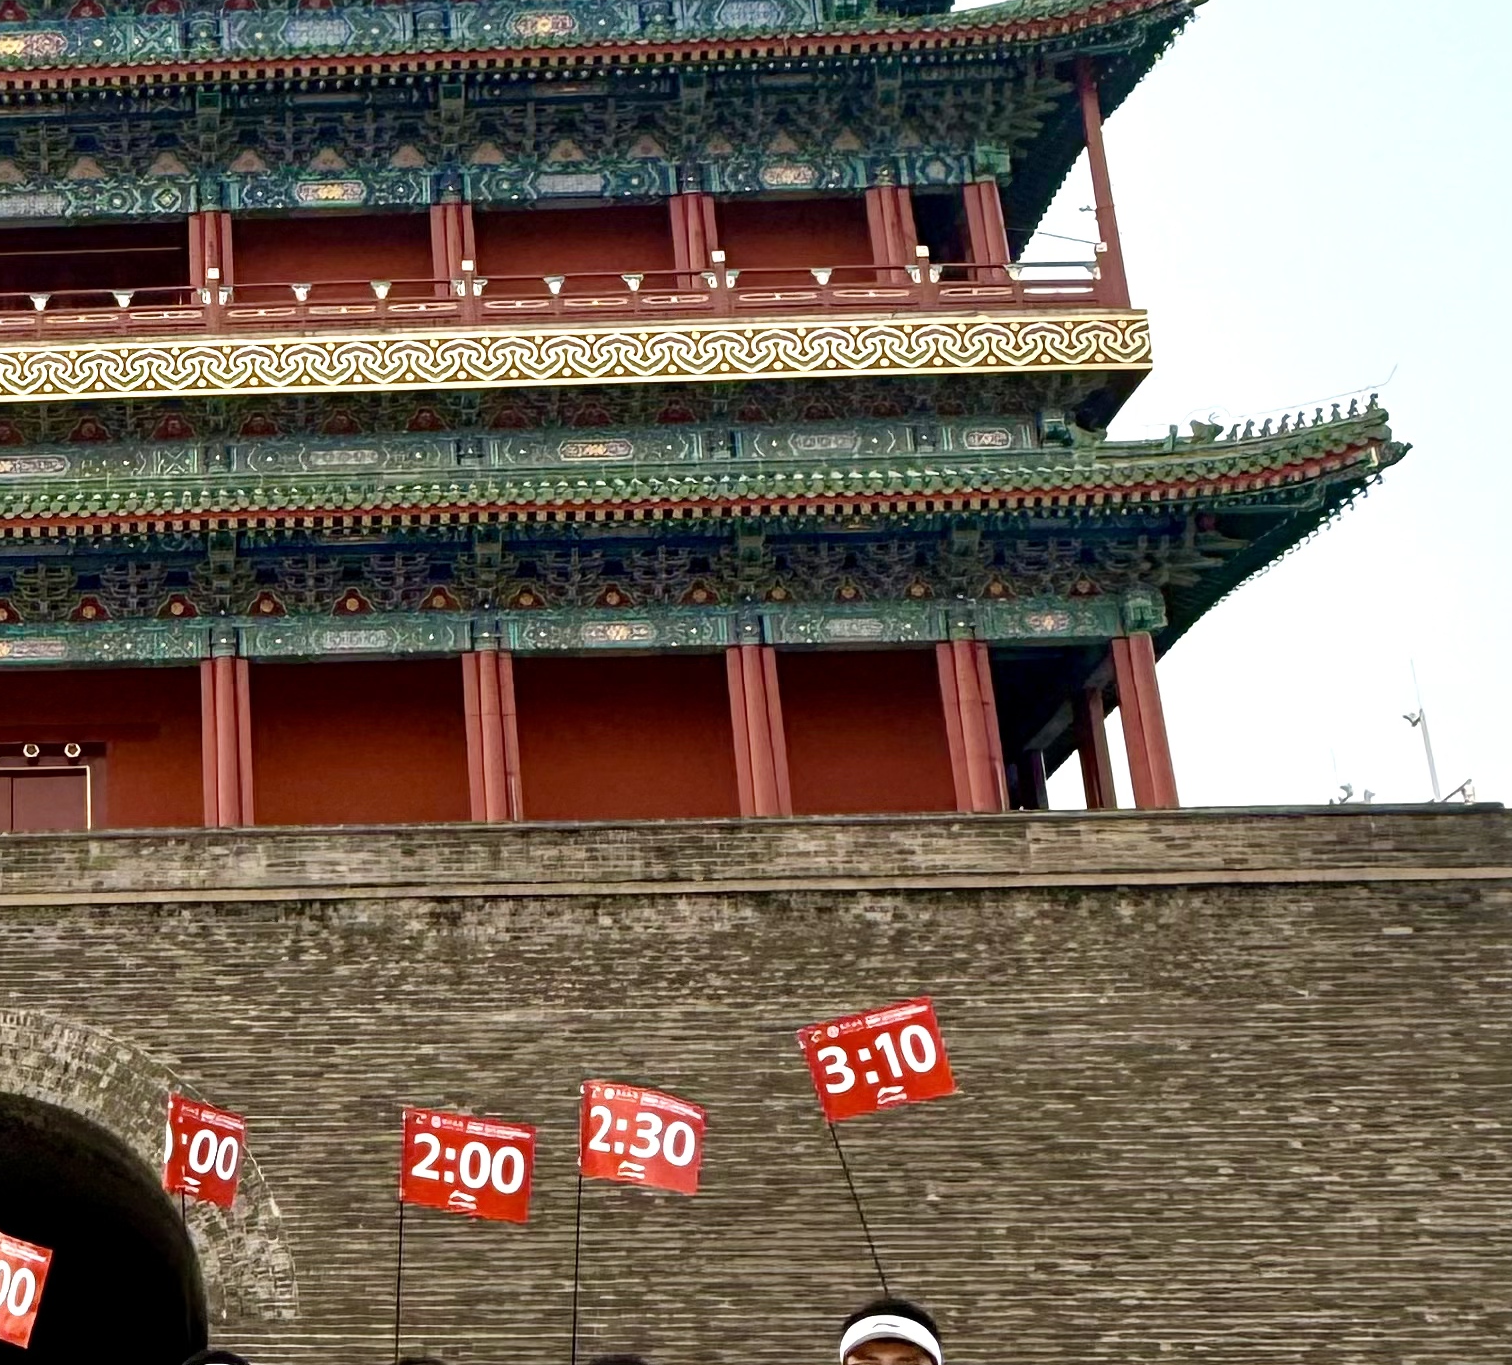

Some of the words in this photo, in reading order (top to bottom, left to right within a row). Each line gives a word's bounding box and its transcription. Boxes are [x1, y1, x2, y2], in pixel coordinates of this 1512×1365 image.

[817, 1024, 937, 1095] 3:10
[411, 1132, 525, 1194] 2:00
[589, 1105, 696, 1167] 2:30
